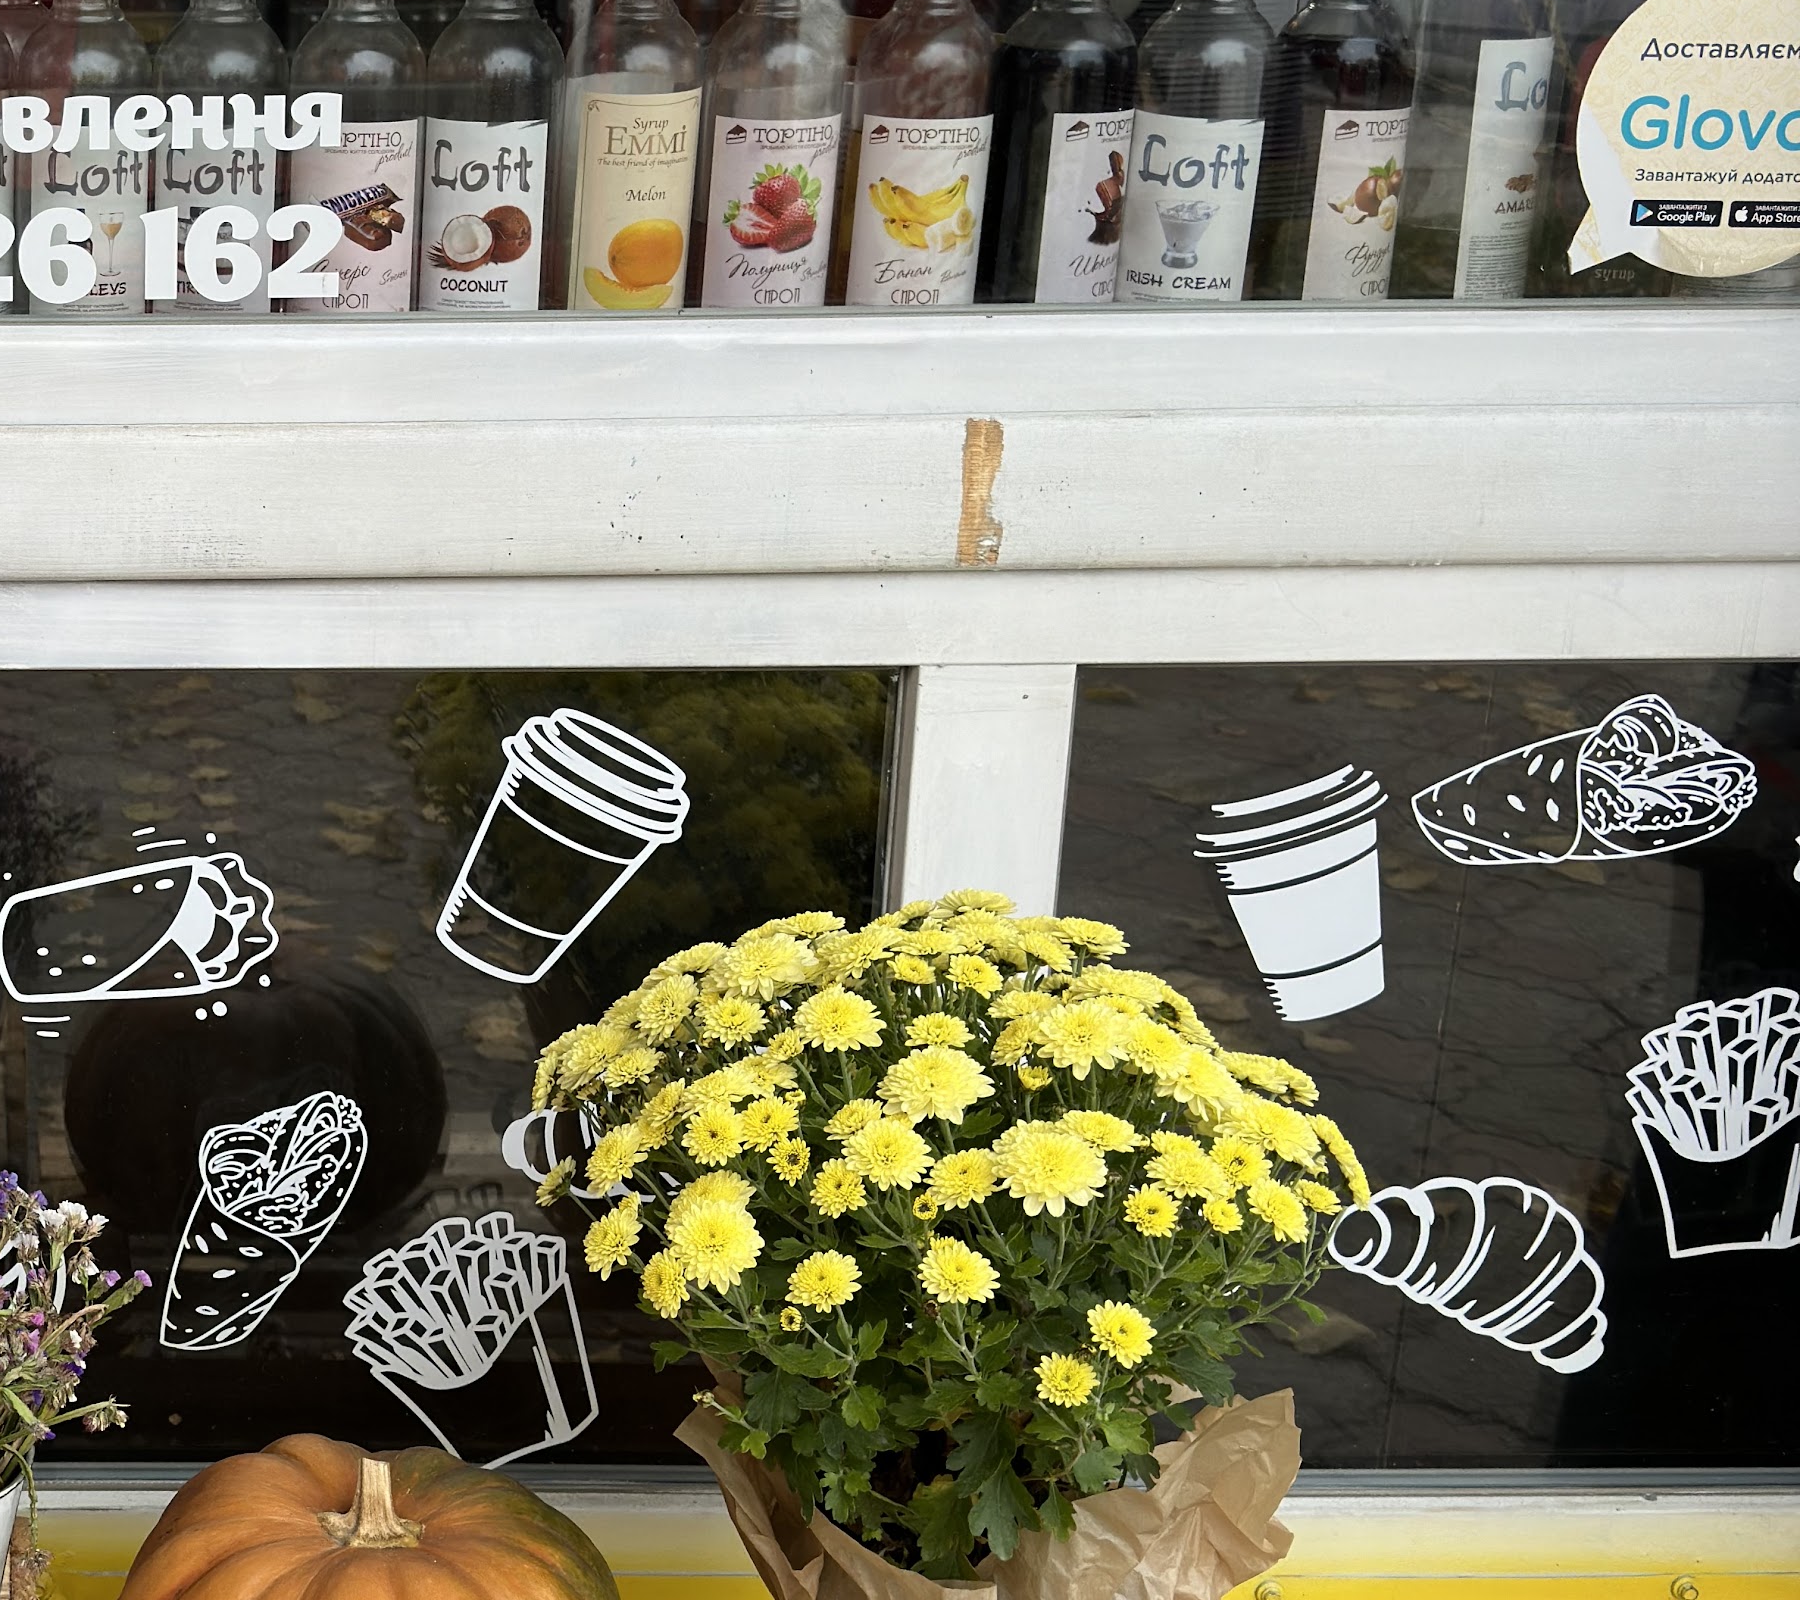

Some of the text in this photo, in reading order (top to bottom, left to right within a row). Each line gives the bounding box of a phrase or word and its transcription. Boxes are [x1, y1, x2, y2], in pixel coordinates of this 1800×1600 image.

[633, 118, 668, 134] Syrup
[753, 125, 833, 144] ТОРТІНО
[341, 132, 401, 147] РТІНО
[896, 127, 980, 144] ТОРТІНО
[163, 145, 265, 195] Loft
[431, 139, 533, 193] Loft
[1138, 134, 1249, 190] Loft
[44, 146, 143, 196] Loft
[1635, 169, 1737, 185] Завантажуй
[625, 186, 666, 201] Melon
[1657, 211, 1716, 224] Google Play
[1751, 212, 1771, 224] App
[139, 204, 344, 302] 162
[874, 259, 933, 284] Банан
[1126, 269, 1231, 290] IRISH CREAM
[1594, 267, 1636, 281] syrup
[440, 277, 508, 293] COCONUT
